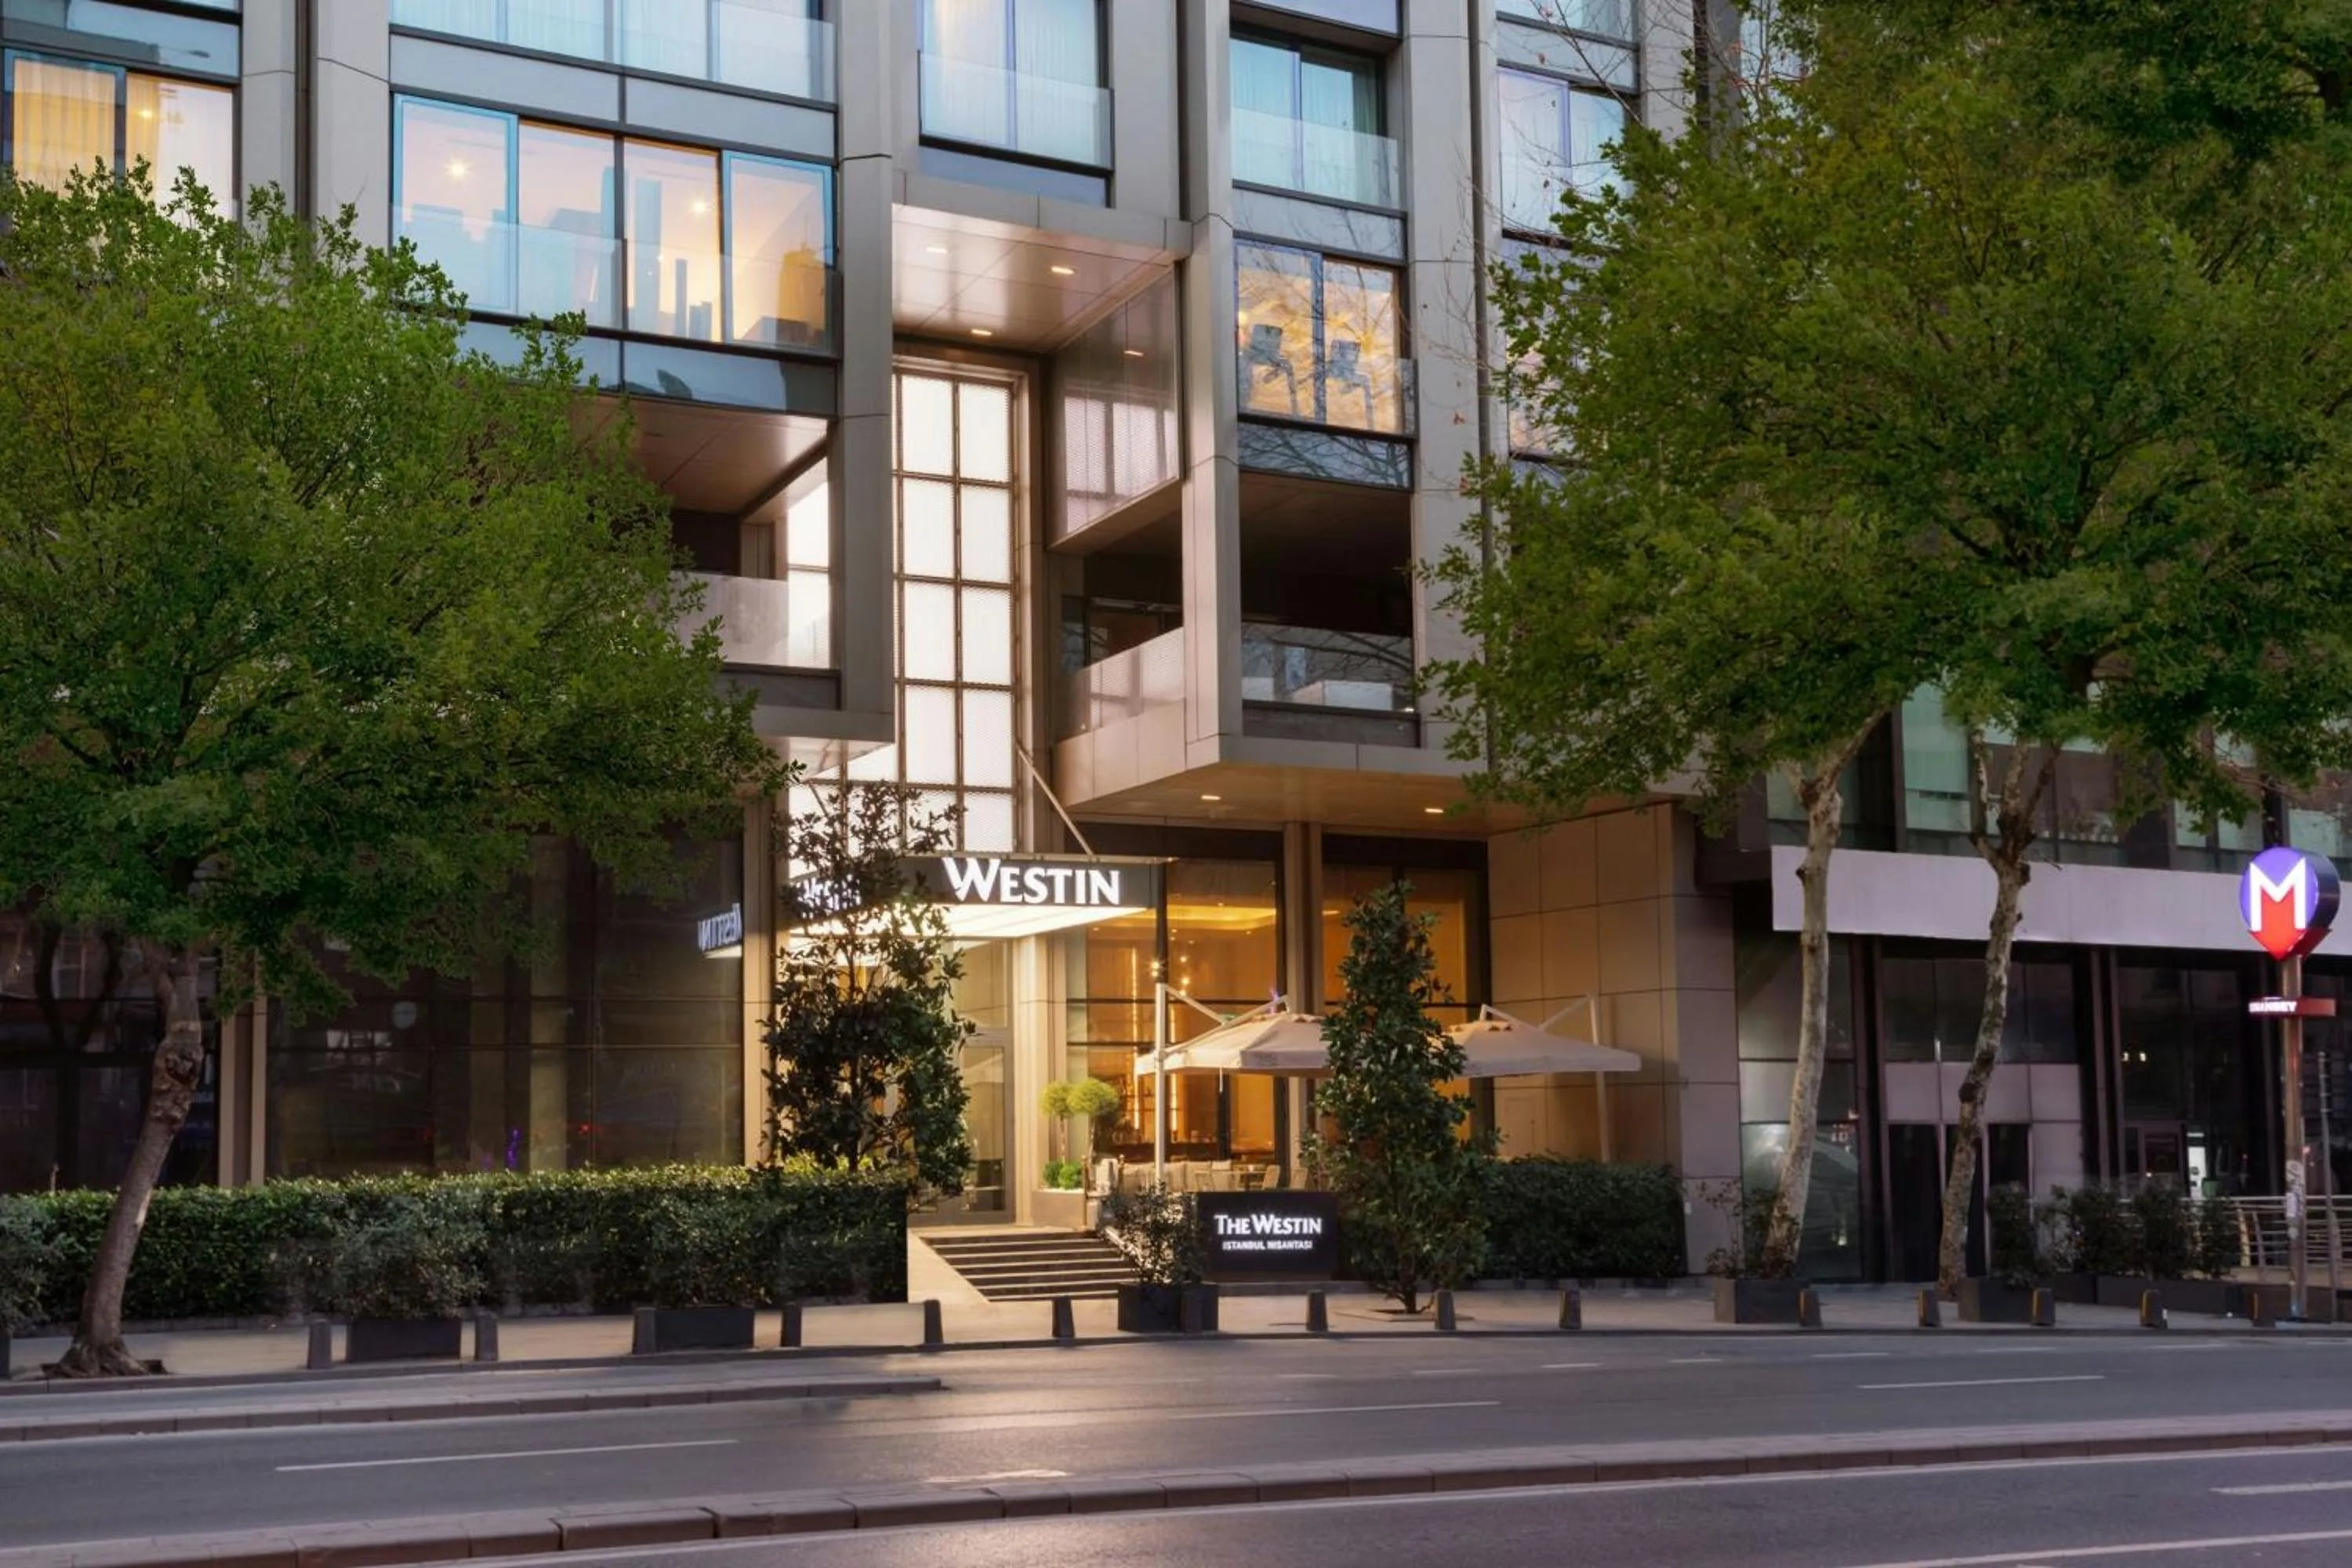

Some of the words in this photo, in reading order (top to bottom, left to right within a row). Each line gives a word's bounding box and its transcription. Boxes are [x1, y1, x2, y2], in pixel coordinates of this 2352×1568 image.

[941, 856, 1120, 905] WESTIN
[2249, 857, 2307, 931] M
[1214, 1214, 1251, 1235] THE
[1250, 1214, 1322, 1235] WESTIN
